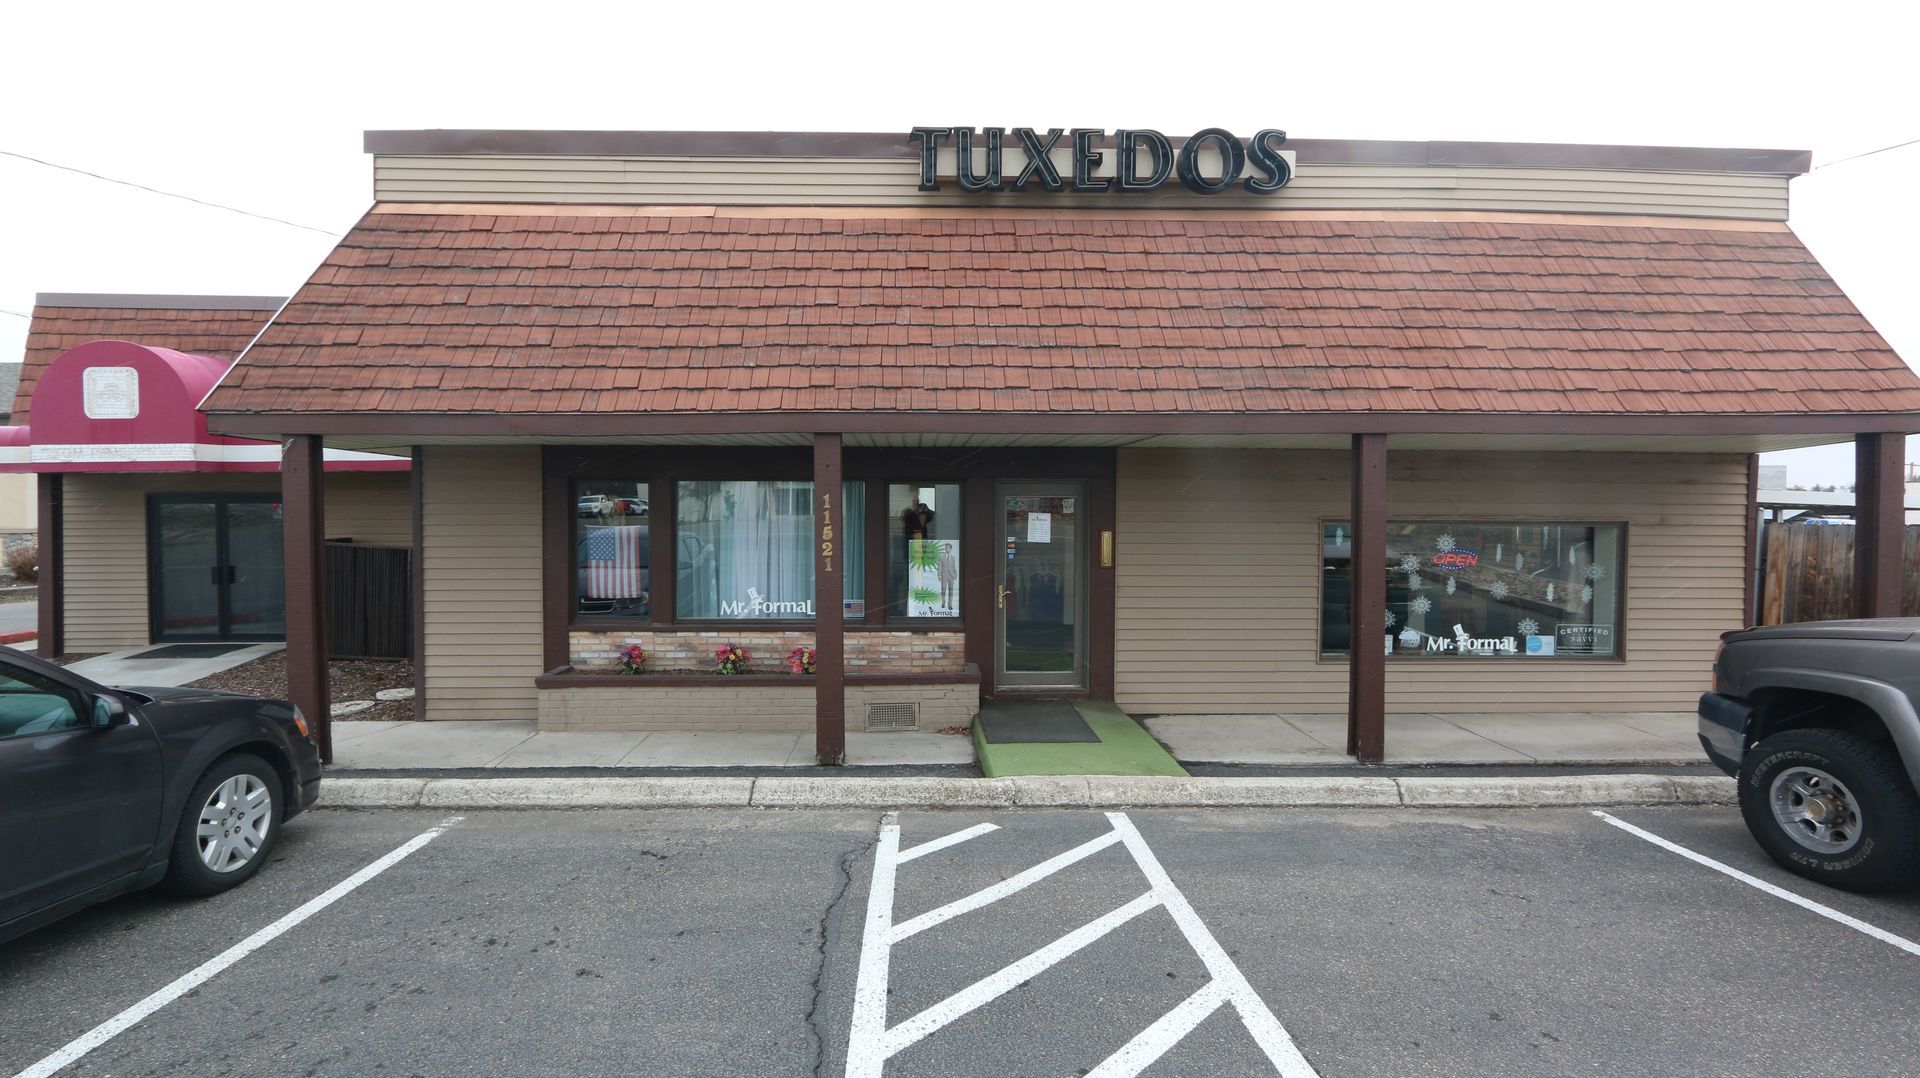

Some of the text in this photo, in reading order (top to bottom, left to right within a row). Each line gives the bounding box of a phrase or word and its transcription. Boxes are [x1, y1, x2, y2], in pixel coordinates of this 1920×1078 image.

[908, 126, 1294, 195] TUXEDOS
[822, 494, 833, 572] 11521
[1432, 553, 1479, 566] OPEN
[720, 601, 748, 616] Mr.
[1560, 627, 1609, 636] CERTIFIED
[1426, 636, 1453, 652] Mr.
